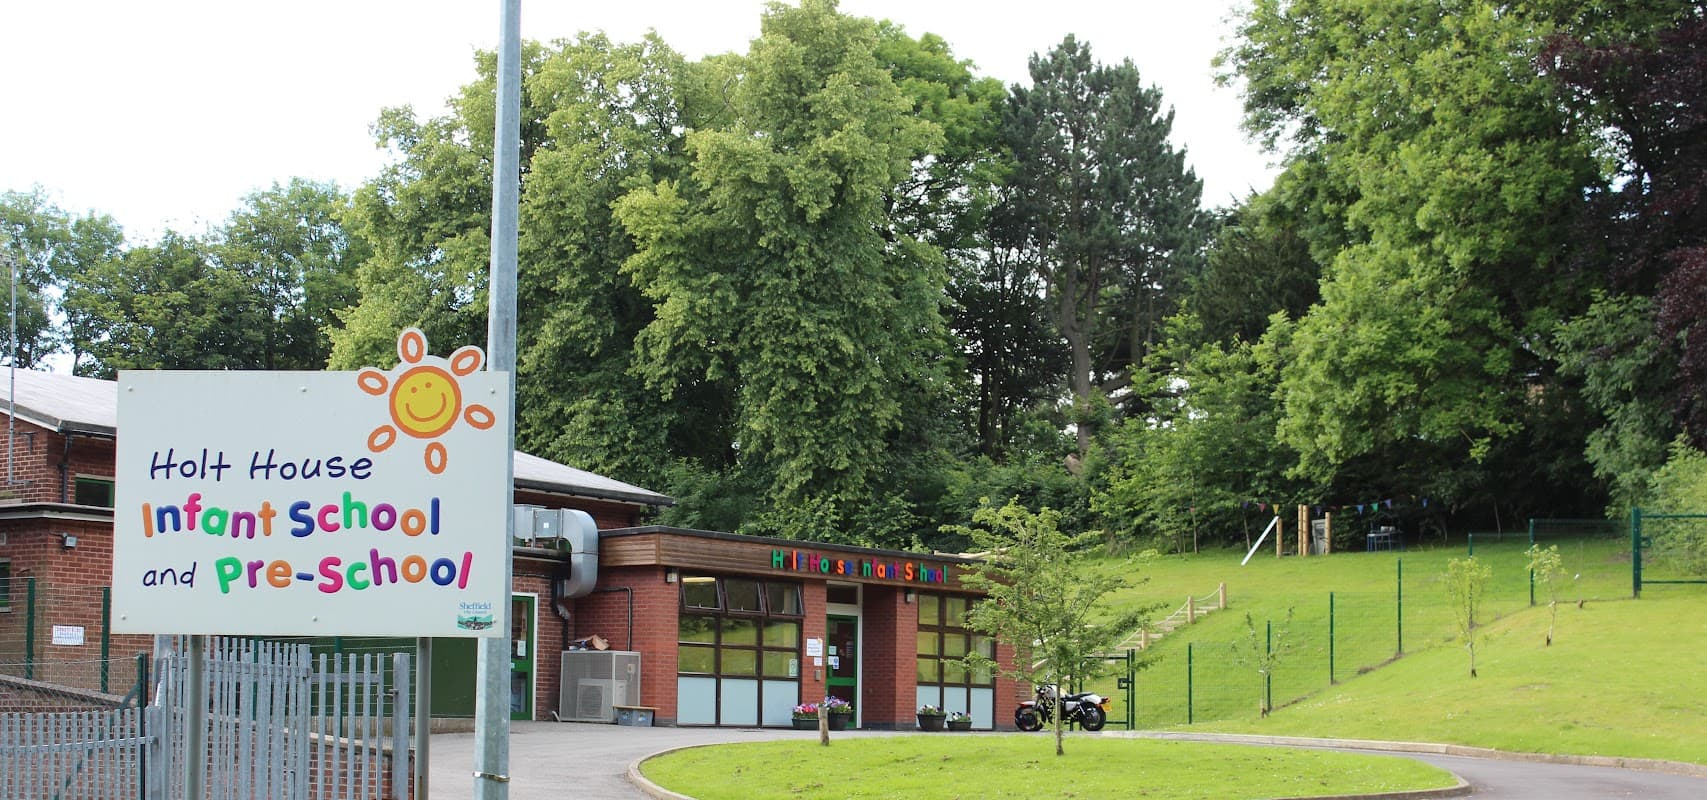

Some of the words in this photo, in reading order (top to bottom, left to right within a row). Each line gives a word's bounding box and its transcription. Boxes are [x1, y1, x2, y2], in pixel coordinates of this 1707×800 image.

[150, 448, 231, 481] Holt
[249, 448, 373, 480] House
[141, 493, 276, 538] Infant
[288, 491, 440, 537] School
[142, 561, 197, 588] and
[215, 548, 473, 593] Pre-School
[808, 552, 853, 575] House
